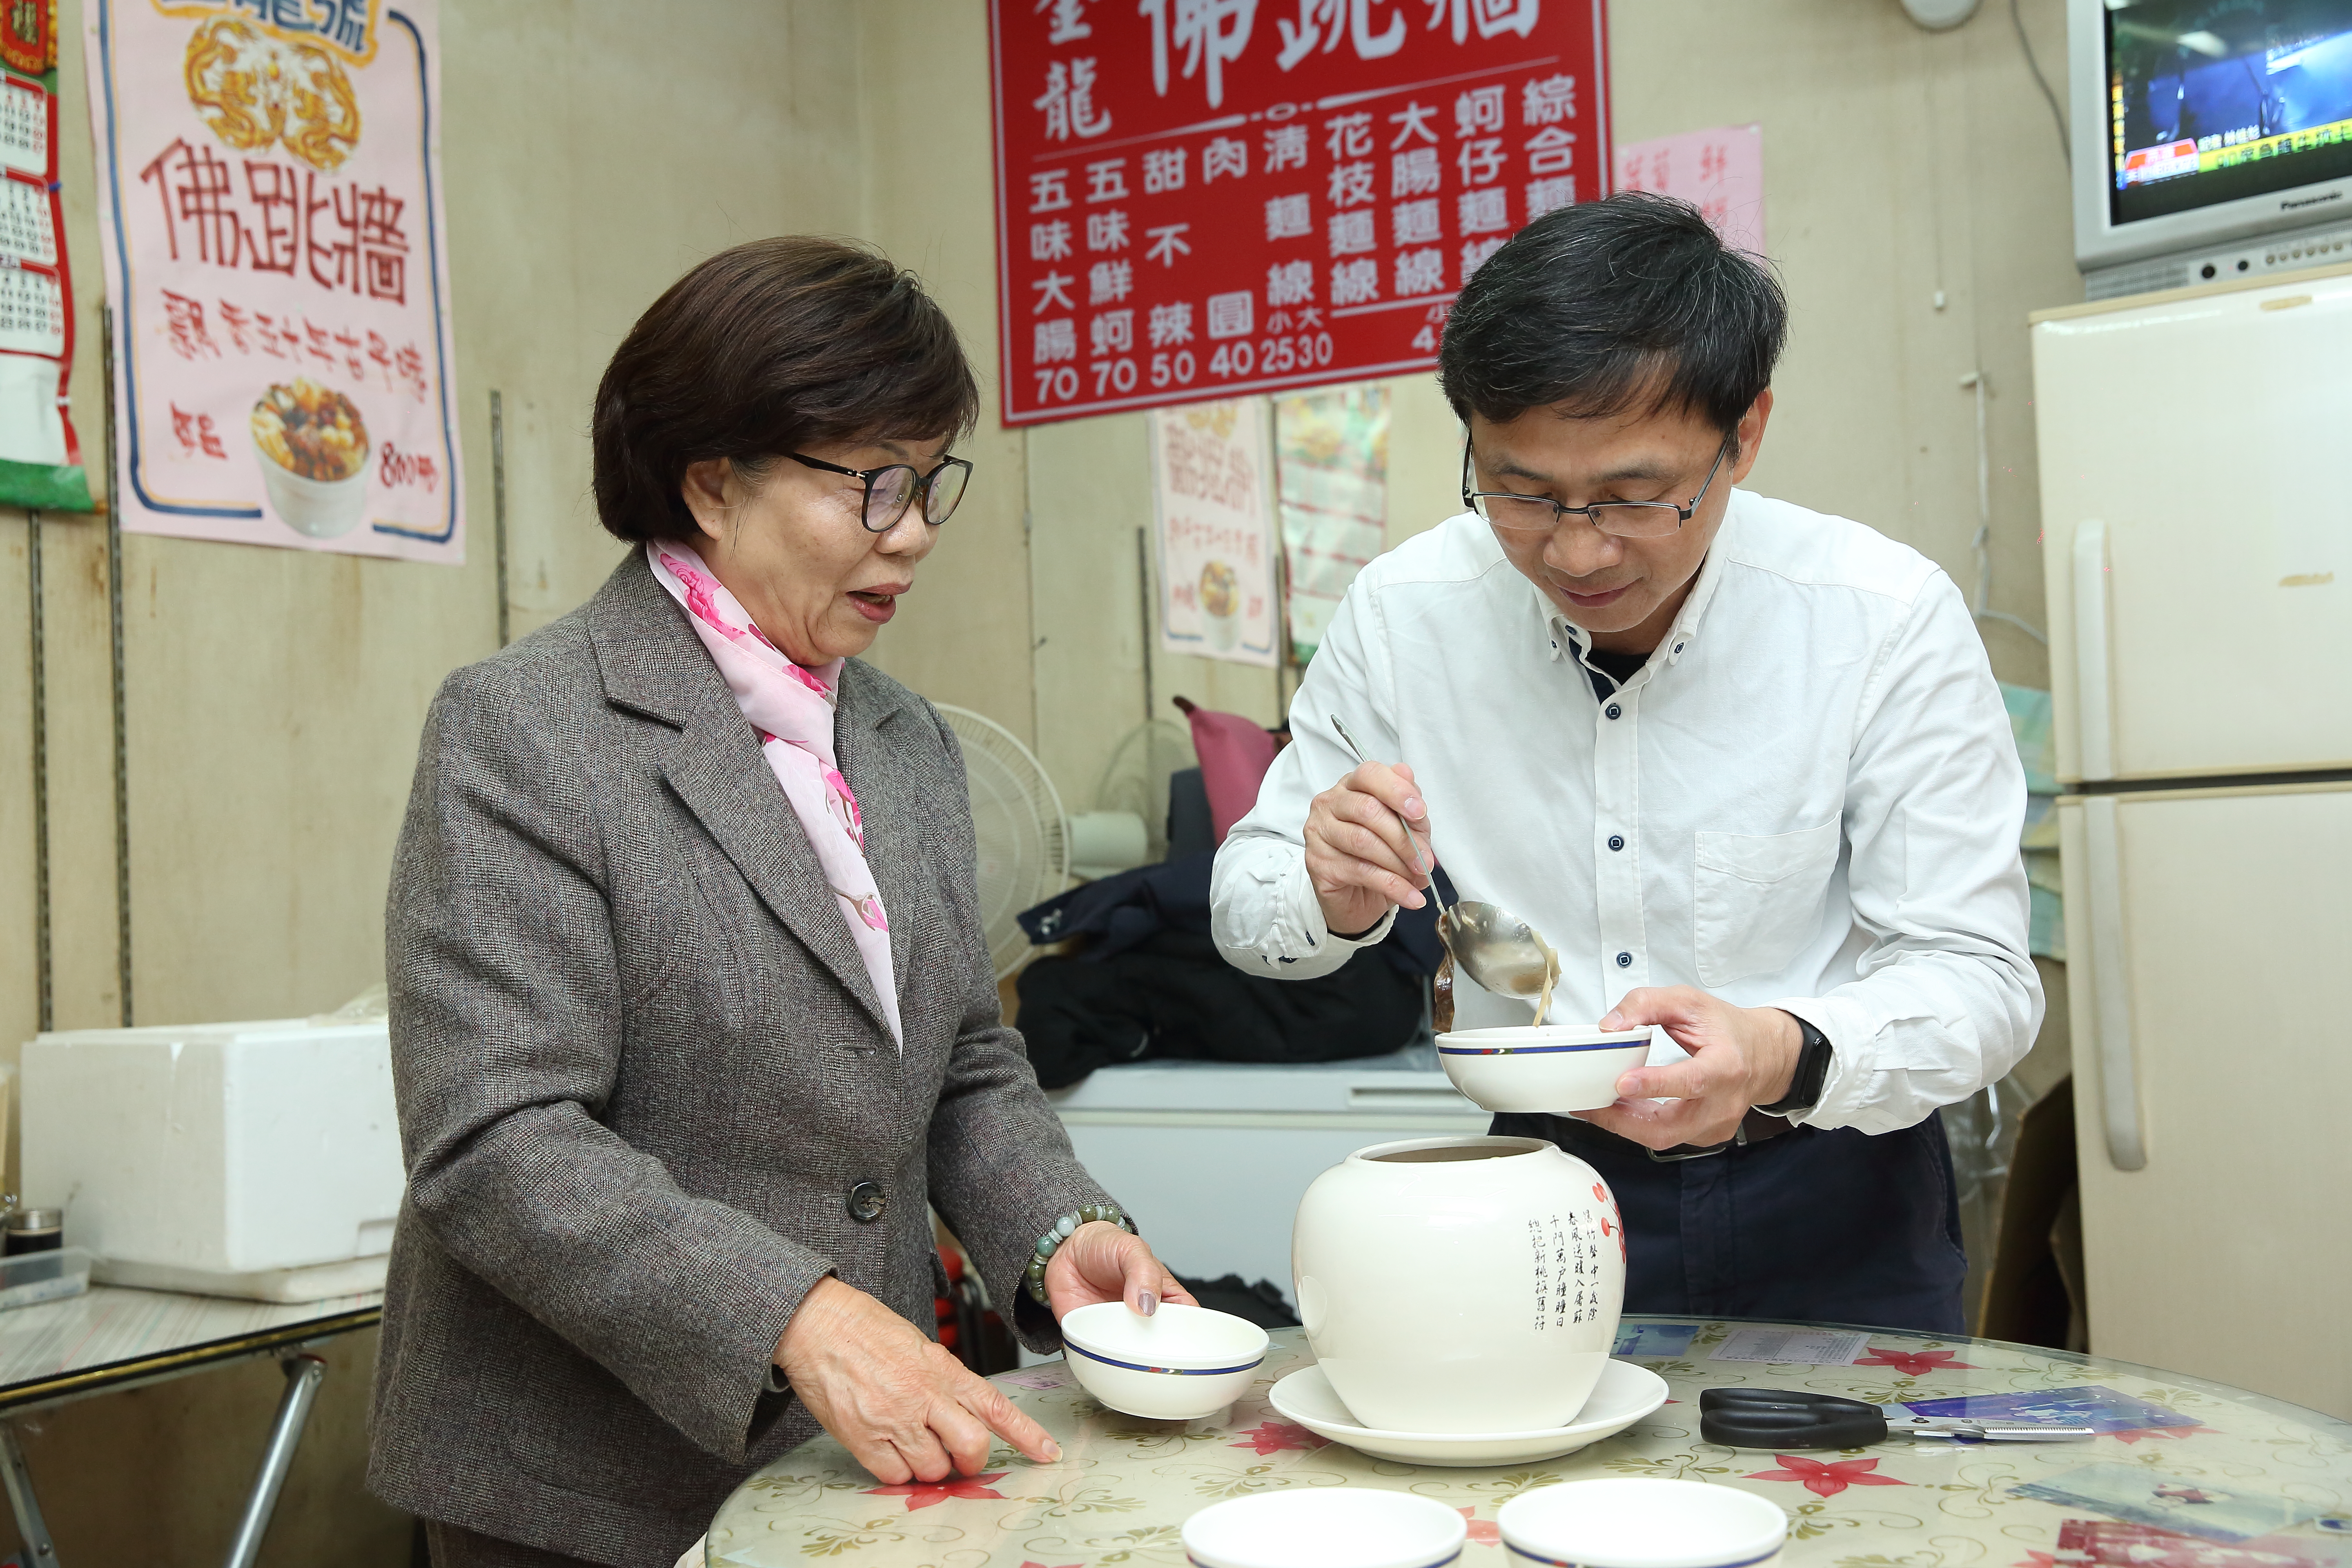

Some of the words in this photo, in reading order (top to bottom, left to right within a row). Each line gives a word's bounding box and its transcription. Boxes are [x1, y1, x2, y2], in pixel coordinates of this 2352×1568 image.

[140, 136, 410, 306] 佛跳牆
[1142, 147, 1195, 349] 甜不辣
[1324, 111, 1380, 306] 花枝麵線
[1388, 100, 1445, 298] 大腸麵線
[2281, 190, 2343, 211] Panasonic
[1029, 167, 1077, 365] 五味大腸
[1085, 158, 1134, 357] 五味鮮蚵
[1150, 350, 1195, 388] 50
[1208, 341, 1255, 378] 40
[1267, 311, 1293, 334] 小
[1296, 306, 1324, 330] 大
[1033, 366, 1079, 403] 70
[1089, 357, 1138, 396] 70
[1568, 1211, 1585, 1323] 春風送暖入屠蘇
